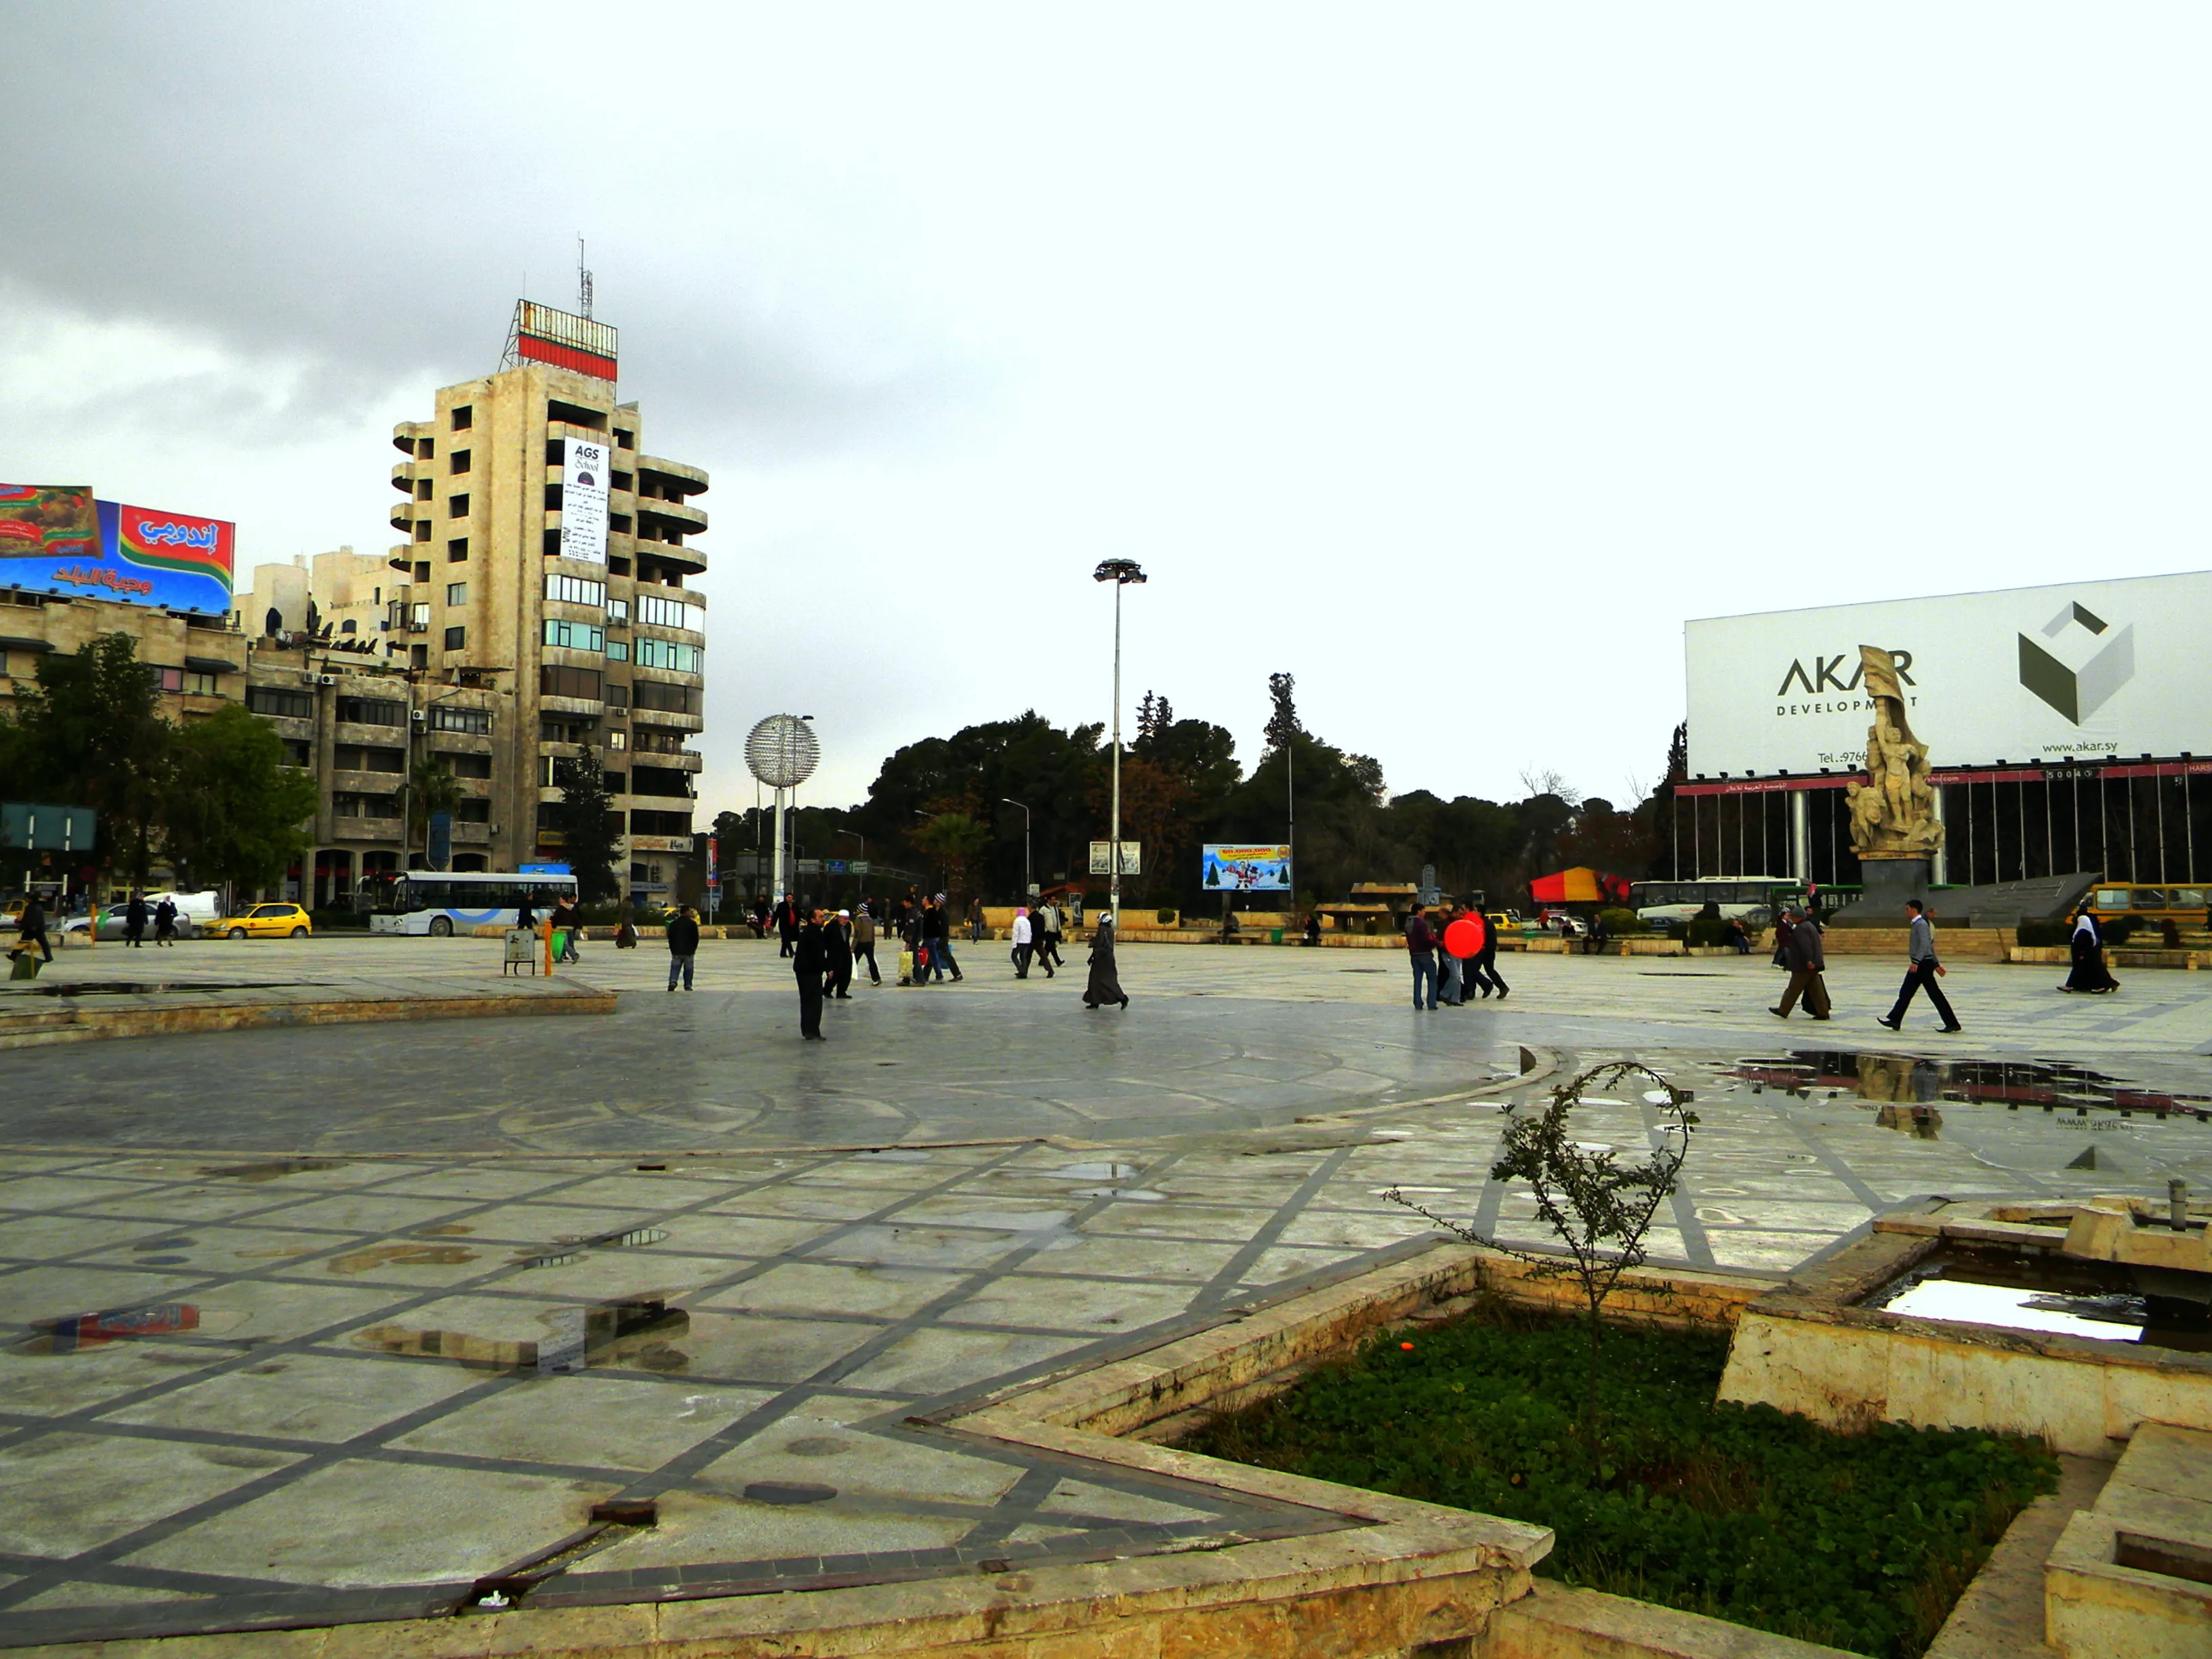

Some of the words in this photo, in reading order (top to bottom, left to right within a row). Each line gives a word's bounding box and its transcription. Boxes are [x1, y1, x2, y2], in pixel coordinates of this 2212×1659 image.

[575, 445, 600, 459] AGS
[575, 458, 599, 472] School
[138, 520, 218, 554] إندومي
[52, 565, 102, 587] البلد
[102, 568, 154, 596] وجبة
[1777, 697, 1917, 716] DEVELOPMT
[2043, 741, 2118, 752] www.akar.sy
